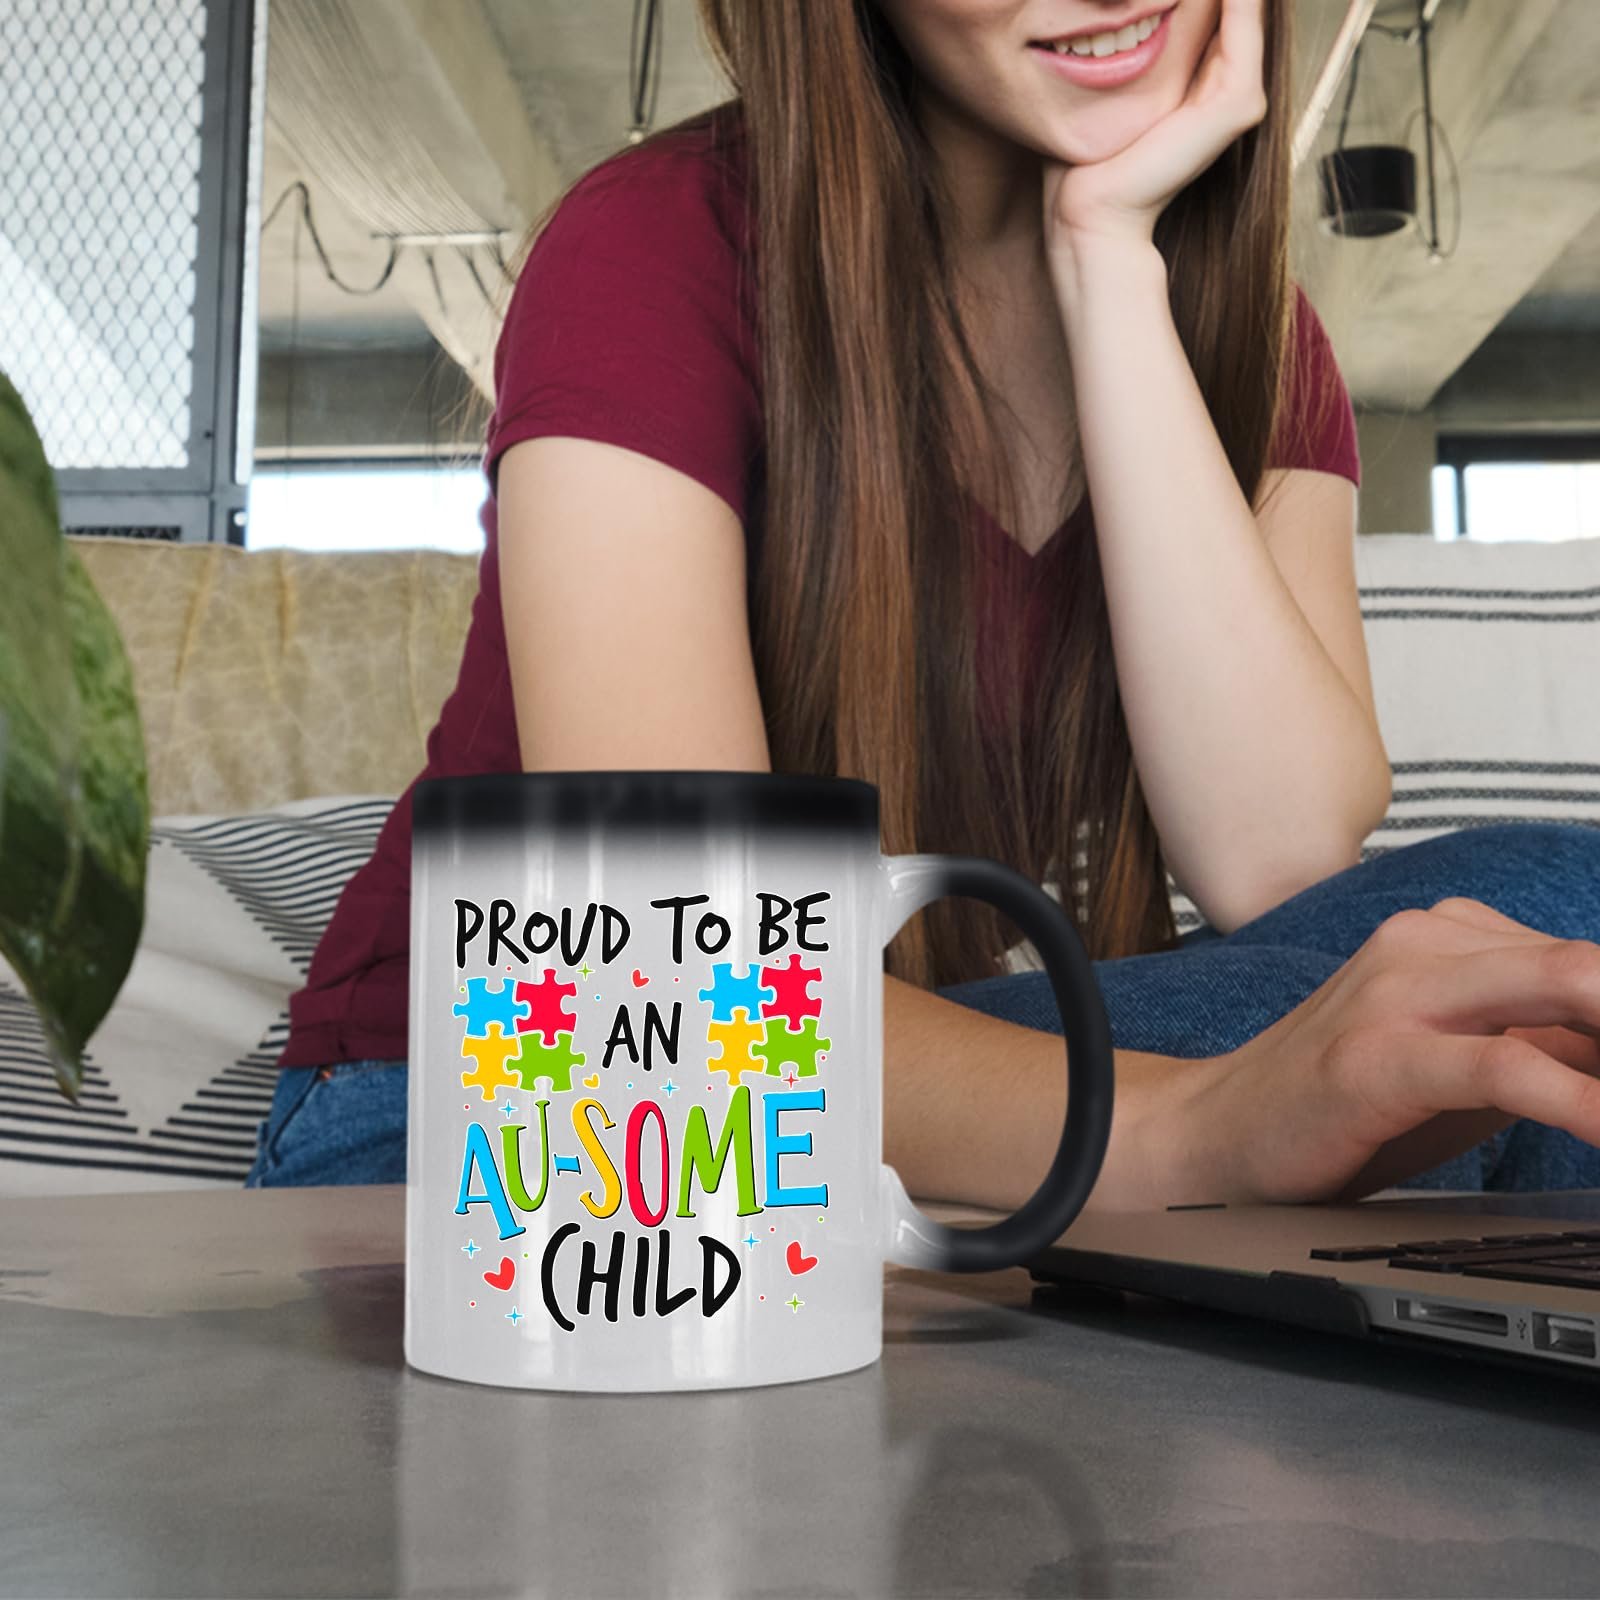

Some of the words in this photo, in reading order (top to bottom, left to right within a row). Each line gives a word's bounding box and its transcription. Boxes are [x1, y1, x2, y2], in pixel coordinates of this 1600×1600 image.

[454, 898, 631, 968] PROUD
[650, 894, 732, 965] TO
[756, 891, 831, 956] BE
[601, 1002, 682, 1071] AN
[454, 1085, 829, 1240] AU-SOME
[540, 1222, 742, 1332] CHILD
